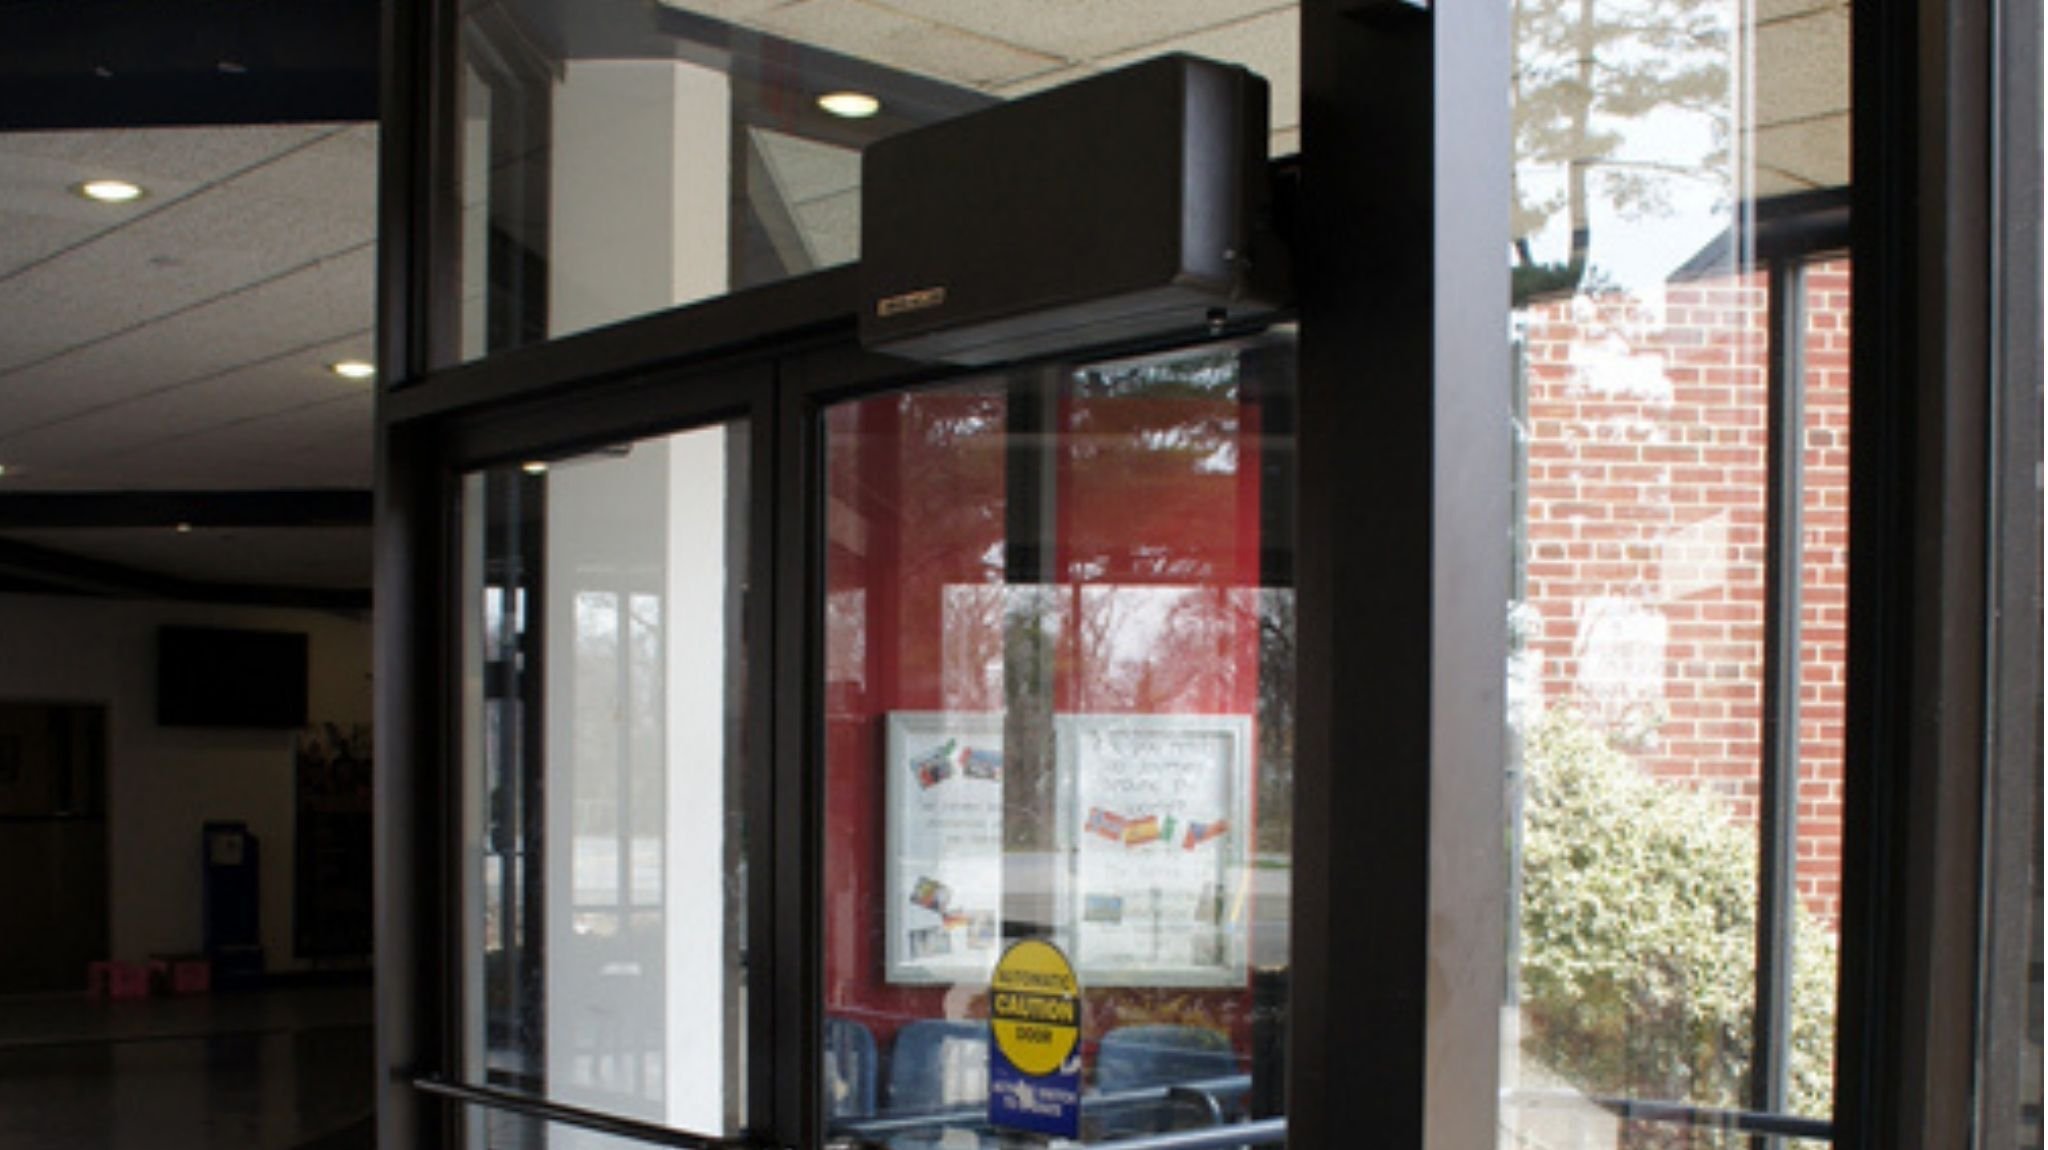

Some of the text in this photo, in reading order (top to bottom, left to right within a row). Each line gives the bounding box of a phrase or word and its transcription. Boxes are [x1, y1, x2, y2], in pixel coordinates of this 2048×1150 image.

[999, 970, 1071, 991] AUTOMATIC
[996, 994, 1073, 1022] CAUTION
[1015, 1026, 1053, 1043] DOOR
